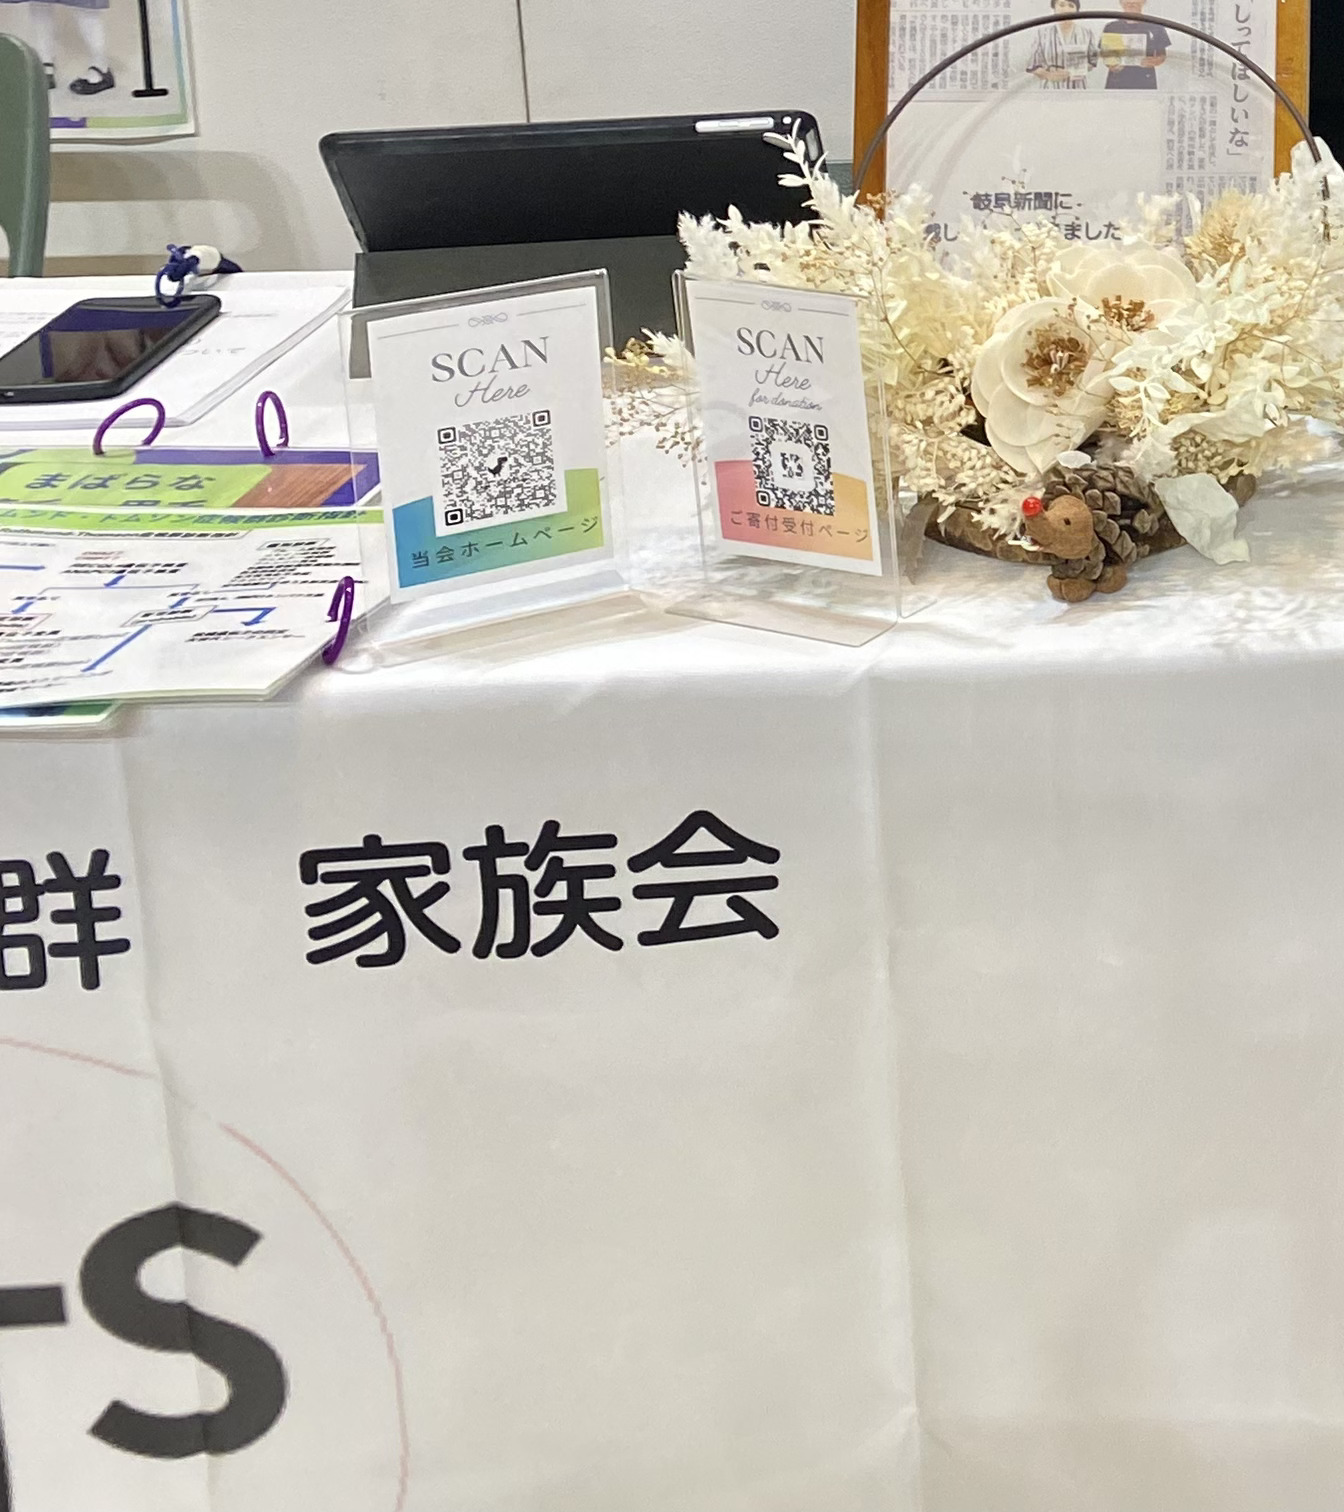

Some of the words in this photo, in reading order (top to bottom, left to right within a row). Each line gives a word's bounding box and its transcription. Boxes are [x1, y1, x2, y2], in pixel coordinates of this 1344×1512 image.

[430, 336, 549, 384] SCAN
[736, 327, 824, 364] SCAN
[455, 376, 530, 407] Here
[755, 362, 812, 390] Here
[410, 515, 600, 570] 当会ホームページ
[729, 507, 870, 545] ご寄付受付ページ
[299, 809, 781, 968] 家族会
